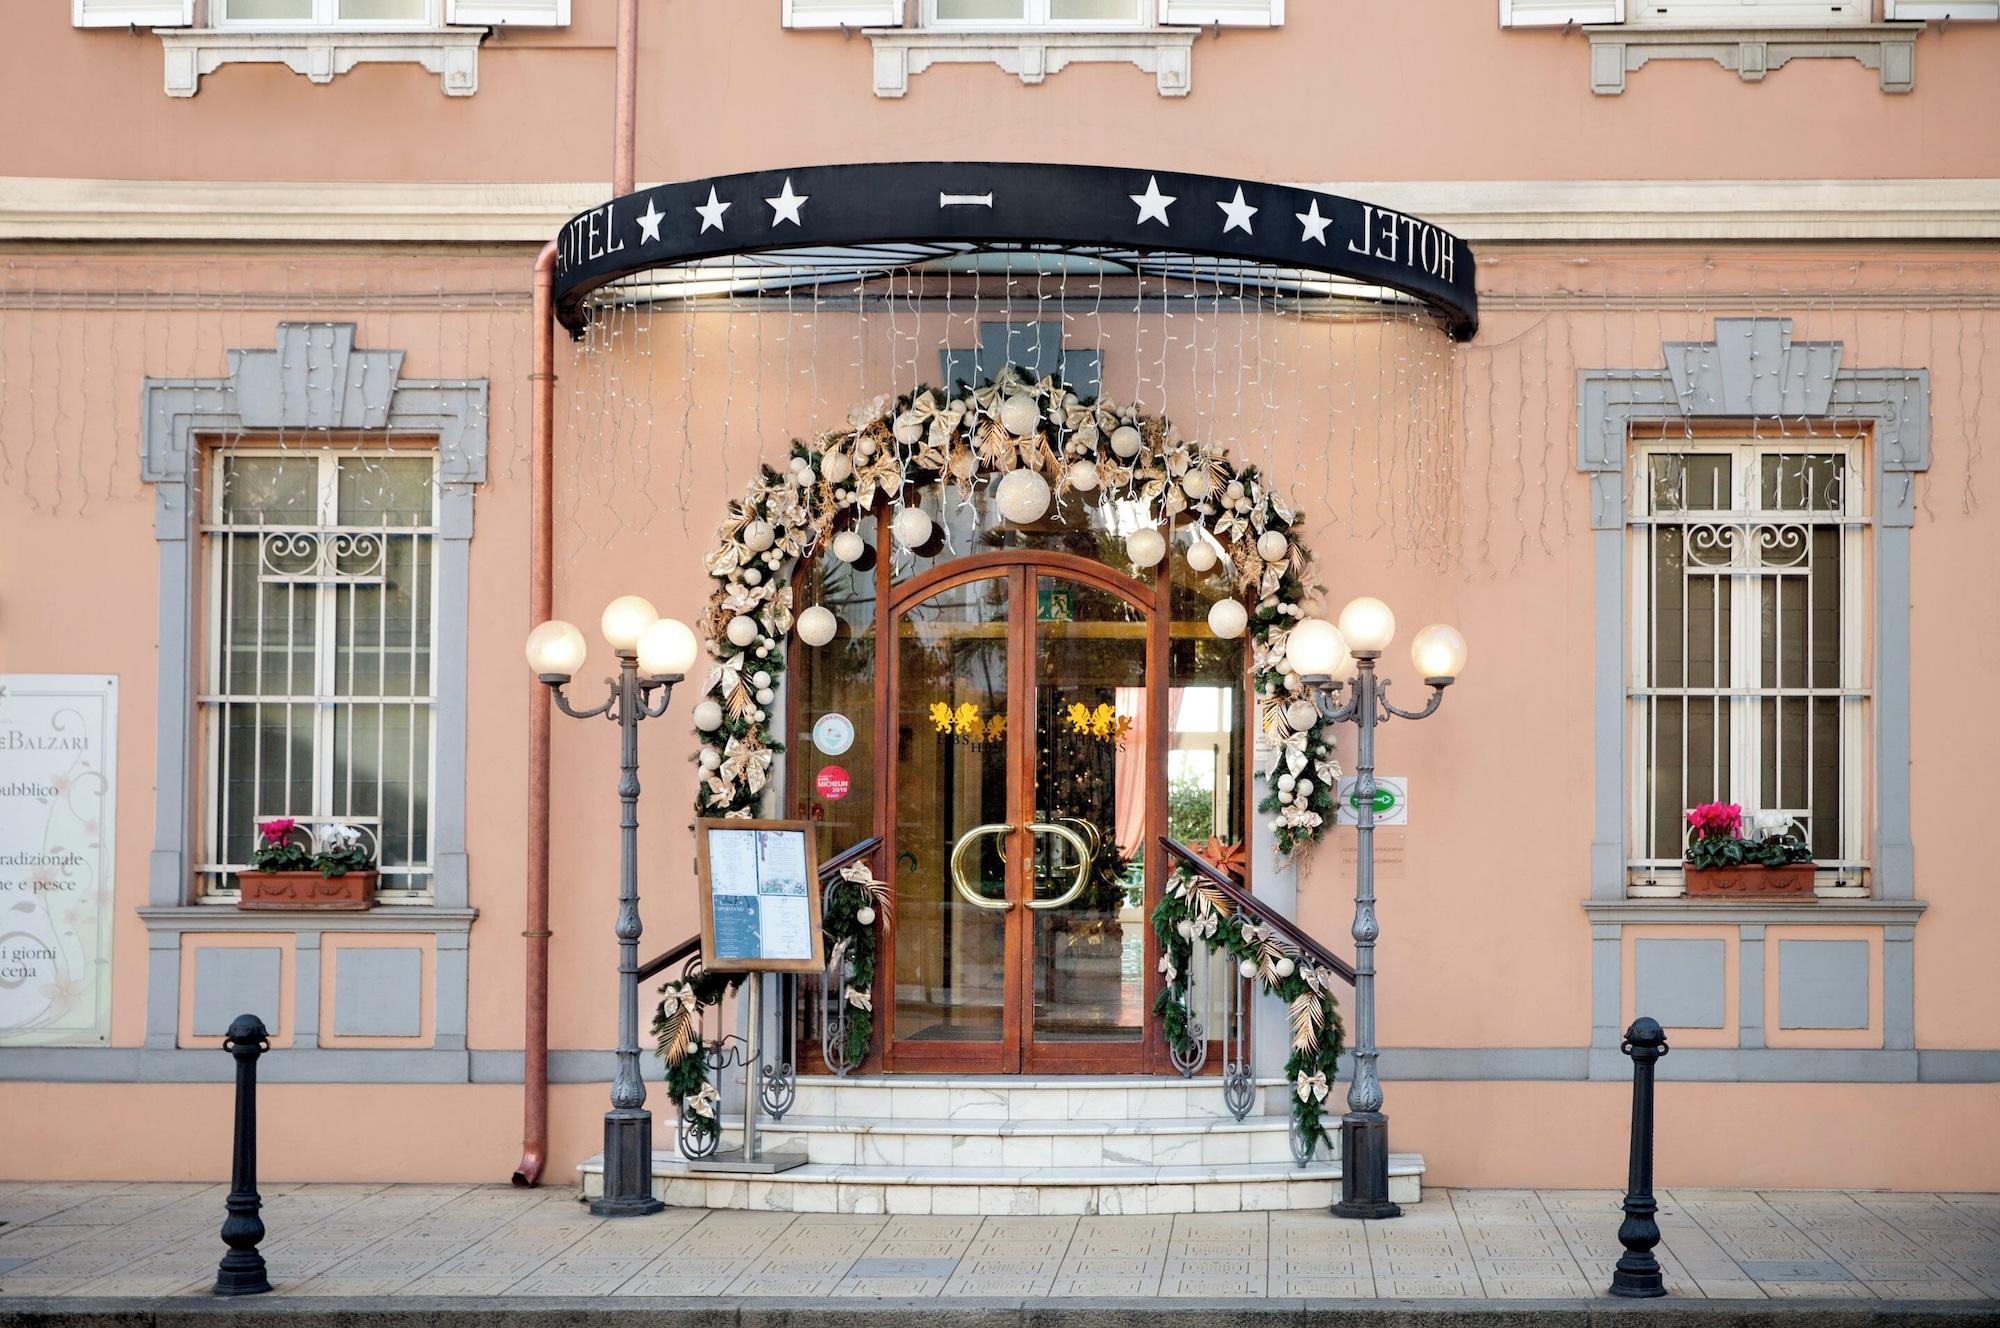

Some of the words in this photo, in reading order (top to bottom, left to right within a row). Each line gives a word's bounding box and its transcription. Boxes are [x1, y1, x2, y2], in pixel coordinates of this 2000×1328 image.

[0, 782, 59, 797] ubblico
[18, 880, 27, 891] e
[33, 880, 76, 895] pesce
[2, 946, 6, 959] i
[11, 946, 56, 963] giorni
[1, 967, 37, 977] cena
